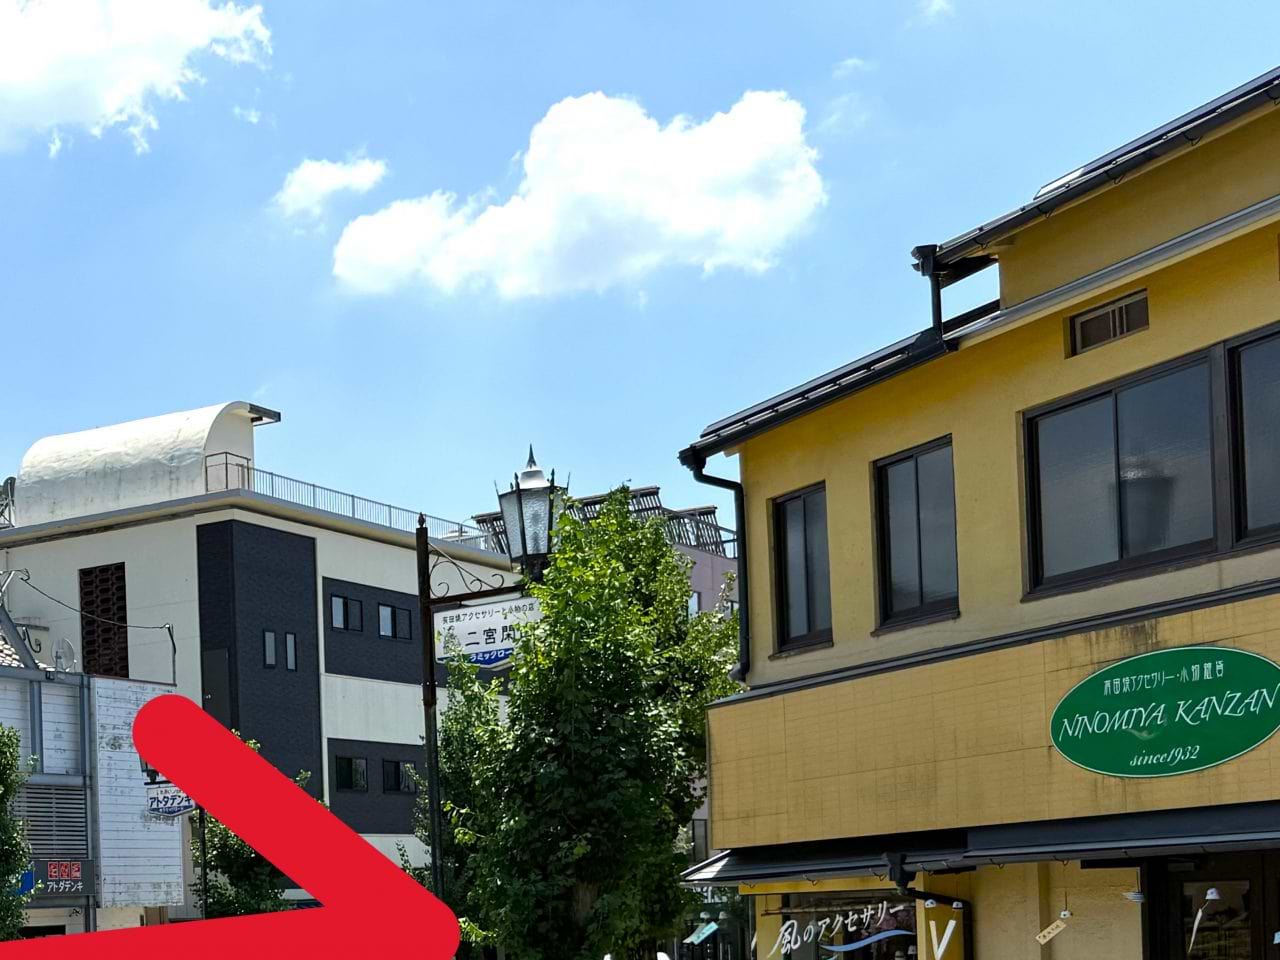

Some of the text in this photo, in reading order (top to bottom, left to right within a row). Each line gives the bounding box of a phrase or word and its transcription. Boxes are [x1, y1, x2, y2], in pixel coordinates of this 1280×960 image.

[1059, 681, 1280, 742] NINOMIYA KANZAN
[46, 880, 84, 893] アトダデンキ
[766, 901, 905, 959] 風のアクセサリー
